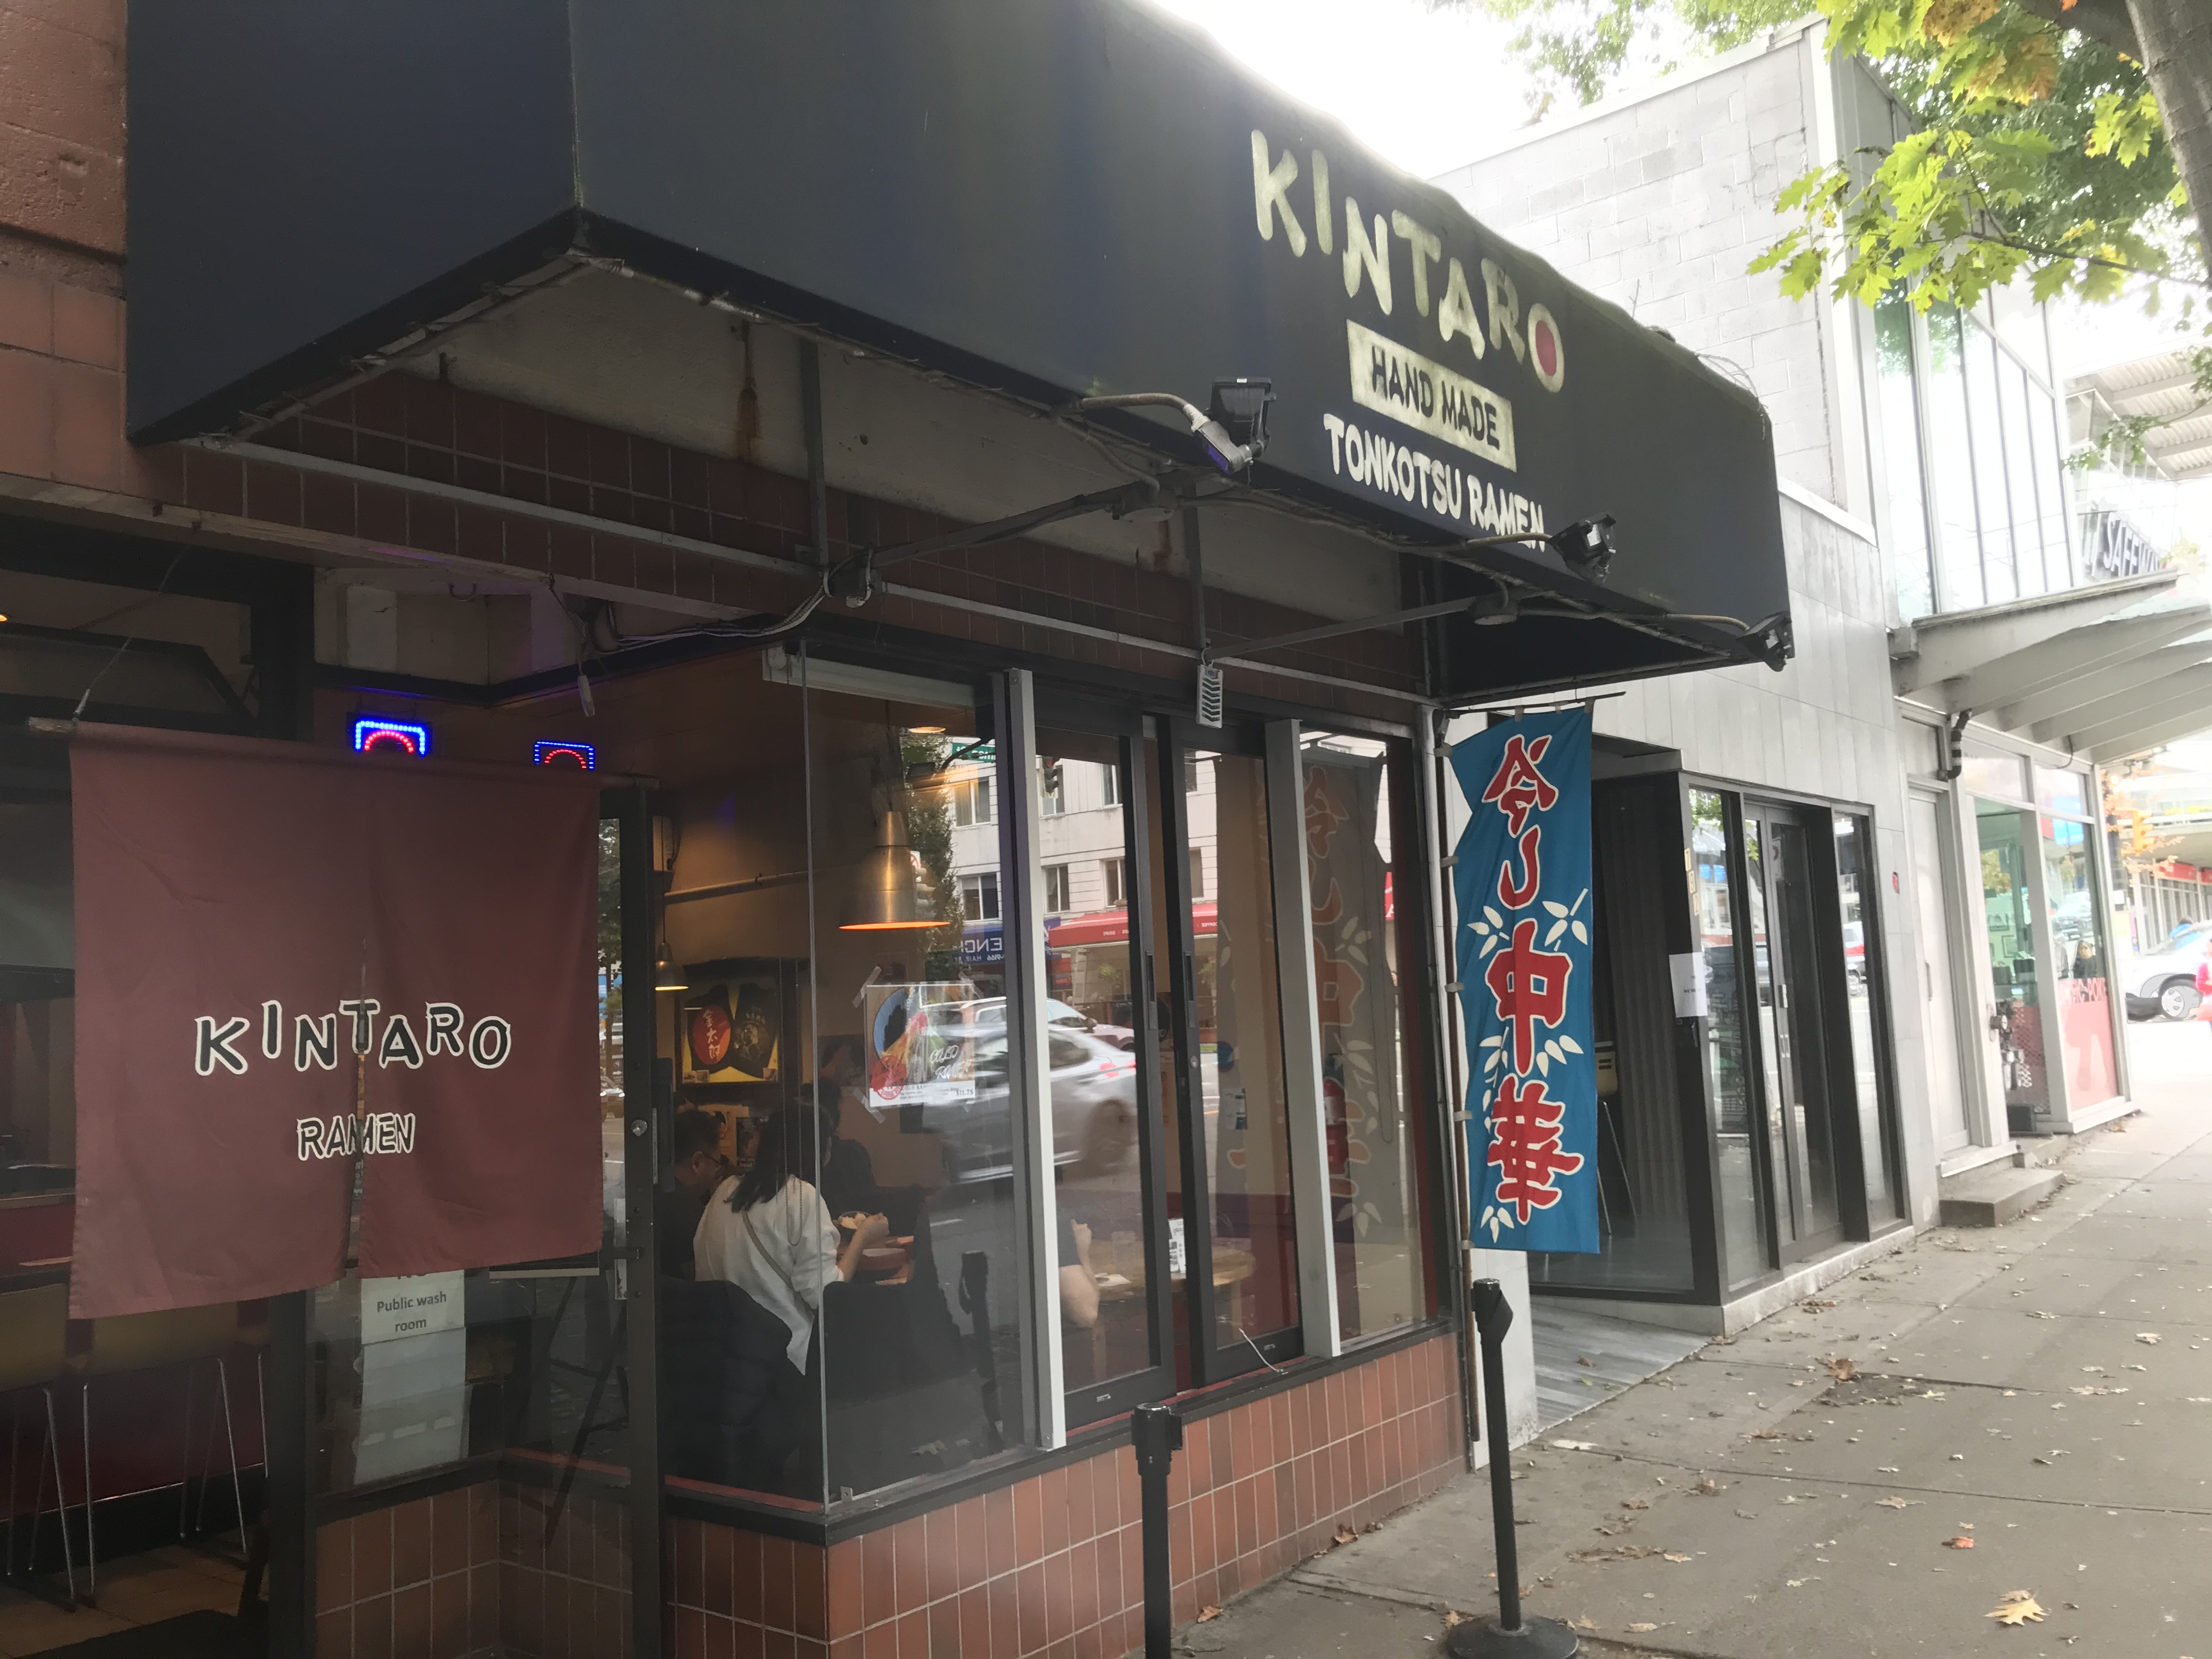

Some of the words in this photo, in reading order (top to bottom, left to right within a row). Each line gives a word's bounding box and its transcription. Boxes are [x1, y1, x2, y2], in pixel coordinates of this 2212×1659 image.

[1251, 129, 1565, 393] KINTARO
[1372, 344, 1433, 418] HAND
[1441, 379, 1500, 452] MADE
[1323, 413, 1462, 519] TONKOTSU
[1467, 474, 1545, 552] RAMEN
[1685, 849, 1699, 916] 792
[194, 998, 511, 1076] KINTARO
[930, 1044, 959, 1064] COLD
[296, 1111, 415, 1161] RAMEN
[376, 1297, 413, 1313] Public
[416, 1291, 447, 1306] wash
[394, 1319, 427, 1332] room
